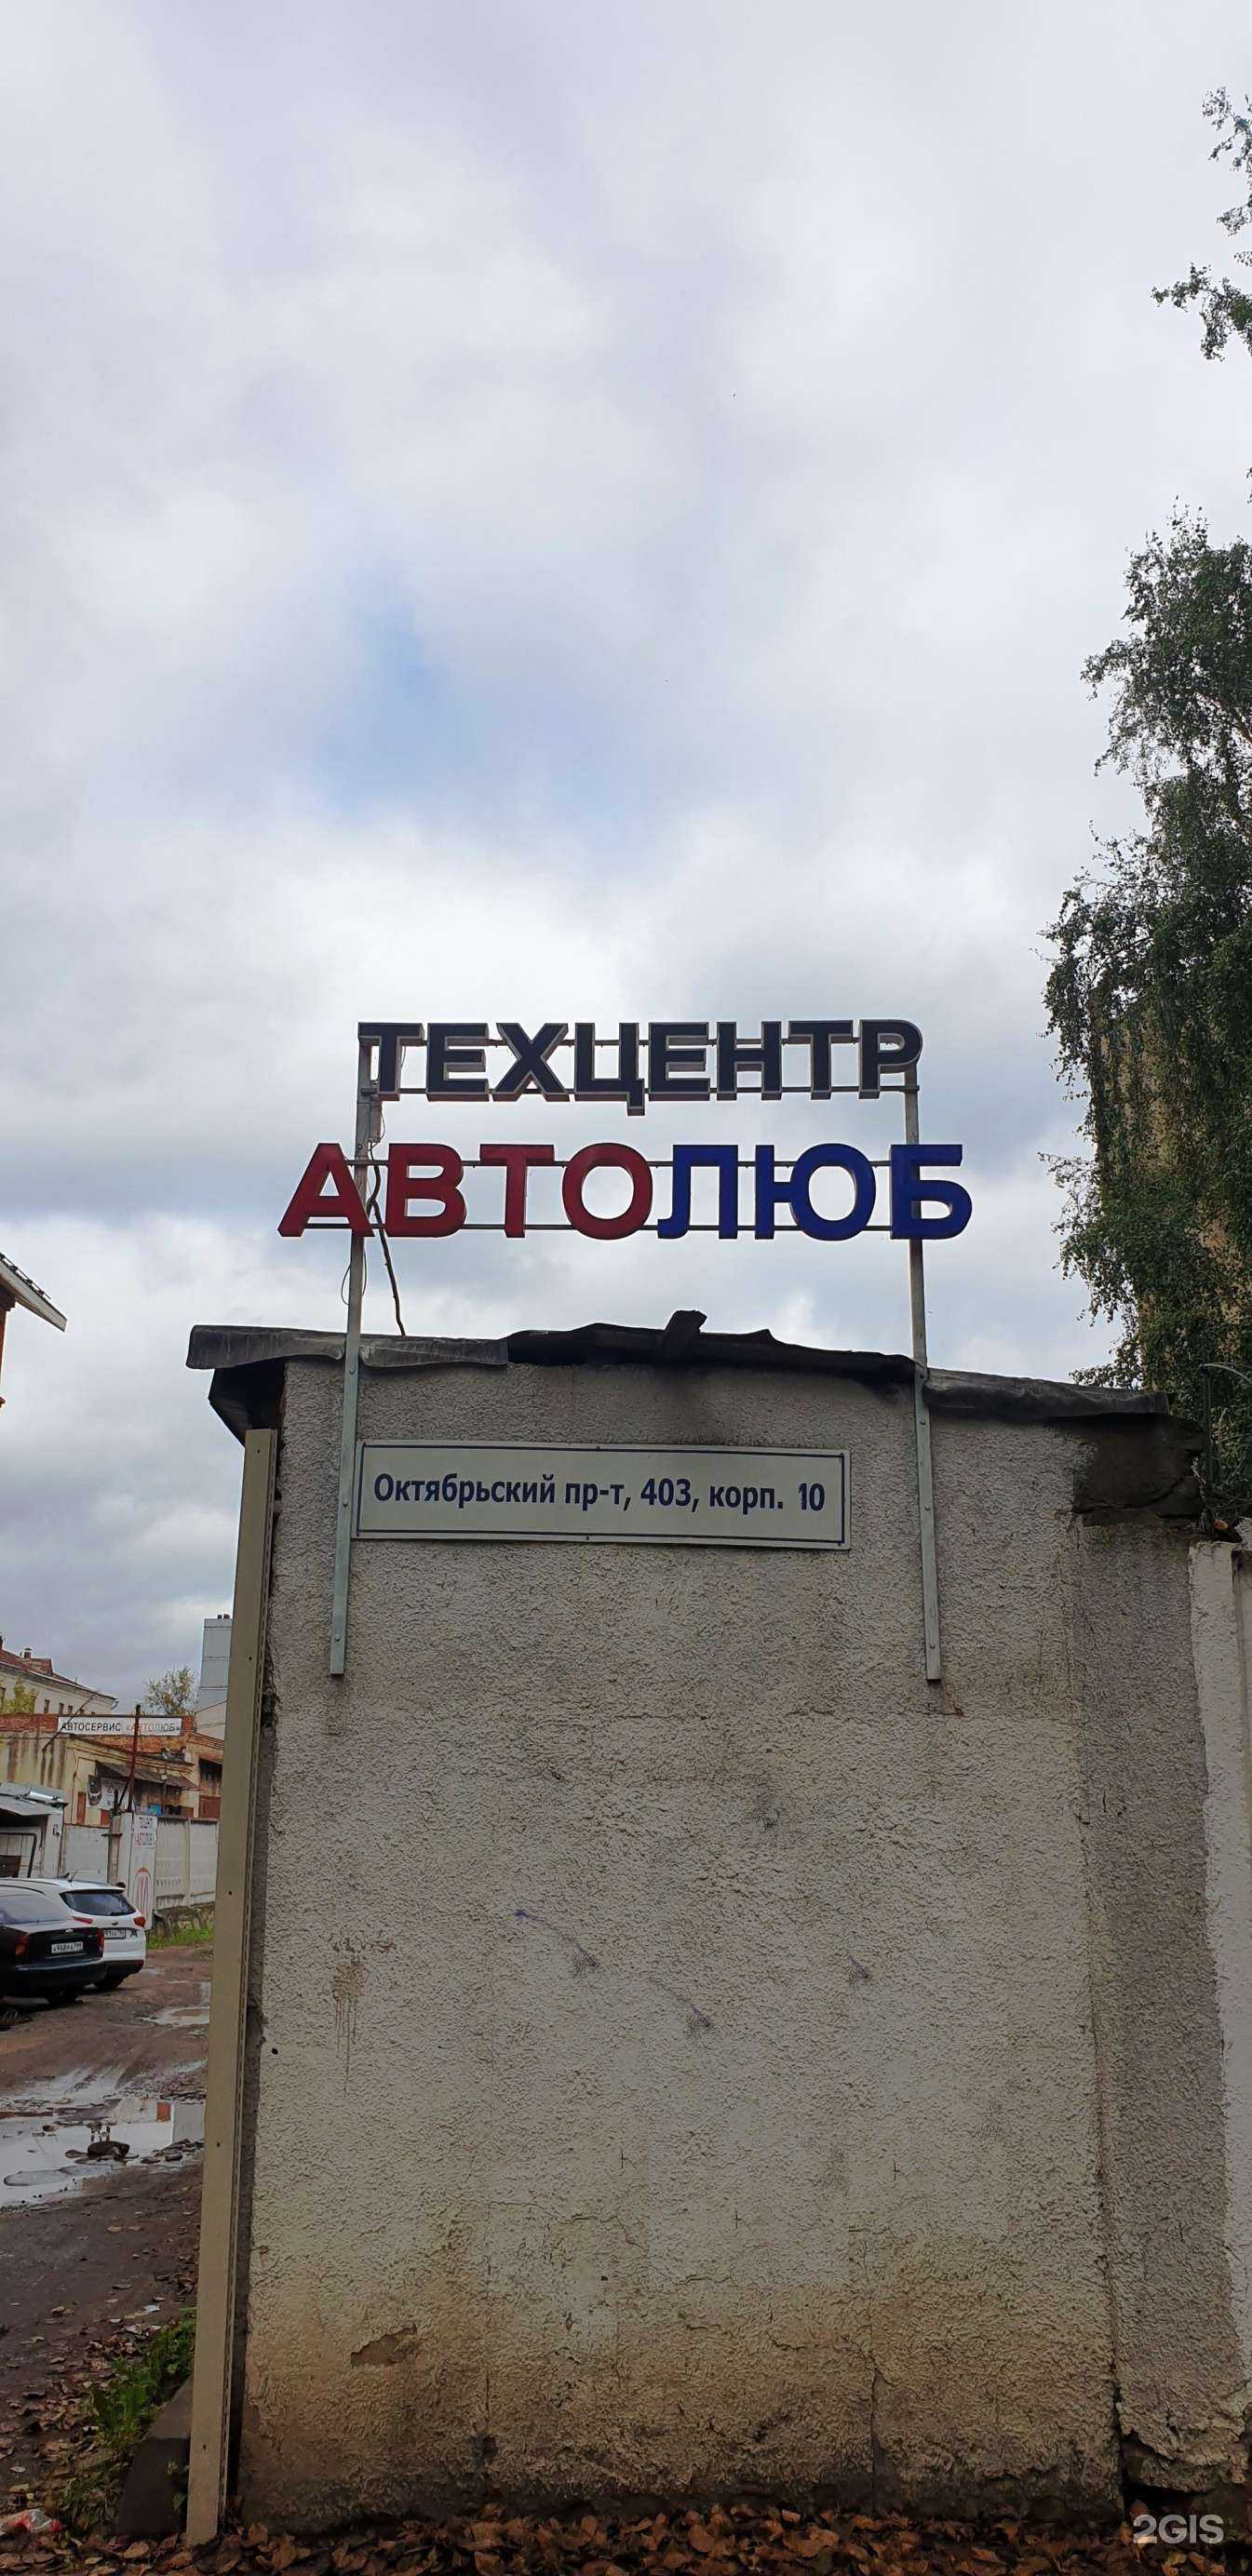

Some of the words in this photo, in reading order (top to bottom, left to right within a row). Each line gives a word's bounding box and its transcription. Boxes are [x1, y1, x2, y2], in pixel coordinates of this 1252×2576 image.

[358, 1019, 923, 1116] ТЕХЦЕНТР
[278, 1142, 973, 1241] АВТОЛЮБ
[373, 1473, 556, 1509] Октябрьский
[565, 1481, 631, 1511] пр-т,
[640, 1478, 699, 1513] 403,
[709, 1484, 784, 1515] корп.
[798, 1483, 825, 1510] 10
[61, 1722, 121, 1732] АВТОСЕРВИС
